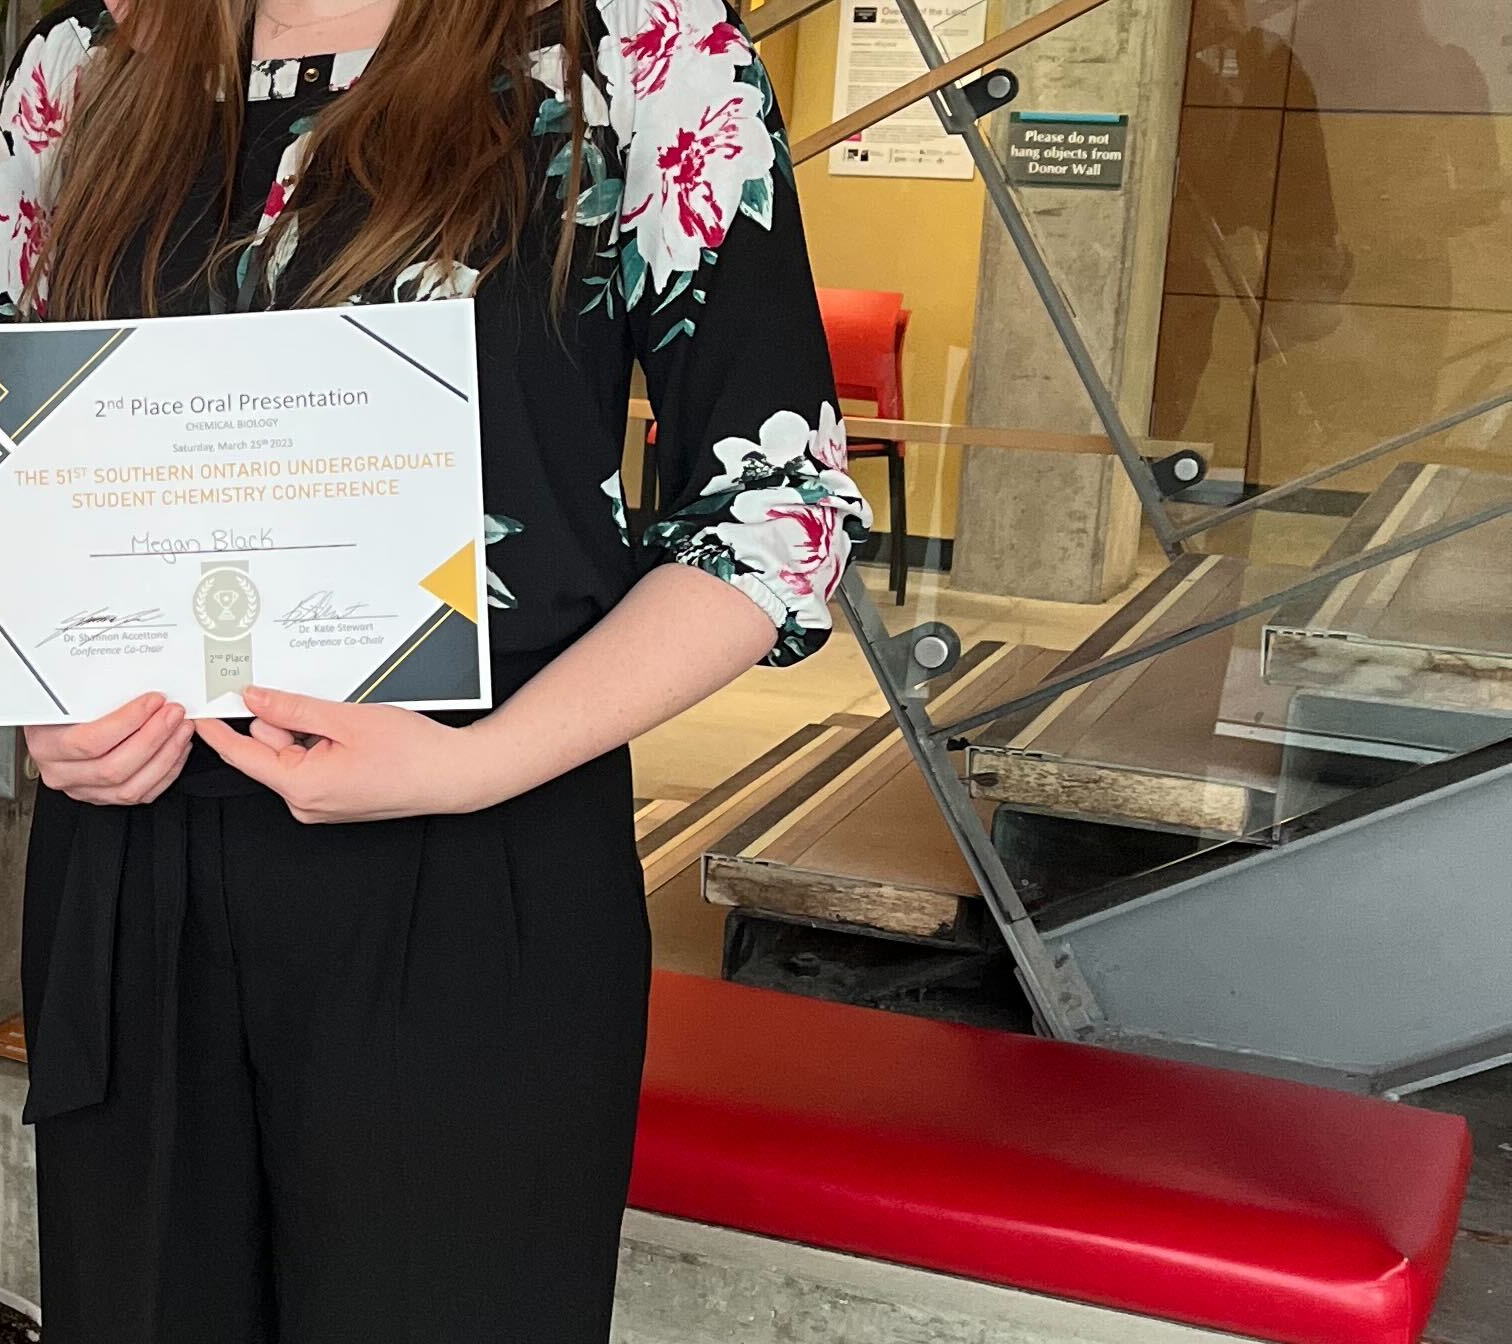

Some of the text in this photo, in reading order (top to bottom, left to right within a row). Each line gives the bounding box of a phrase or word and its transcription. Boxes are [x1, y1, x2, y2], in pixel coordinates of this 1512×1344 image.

[1025, 130, 1110, 145] Please do not
[1010, 144, 1122, 161] hang objects from
[1028, 162, 1102, 176] Donor Wall
[95, 388, 369, 418] 2nd Place Oral Presentation
[185, 417, 279, 432] CHEMICAL BIOLOGY
[217, 440, 248, 451] March
[270, 438, 294, 449] 2023
[14, 451, 456, 486] THE 51ST SOUTHERN ONTARIO UNDERGRADUATE
[72, 479, 401, 510] STUDENT CHEMISTRY CONFERENCE
[131, 527, 274, 564] Megan Black
[314, 623, 336, 633] Kate
[337, 622, 374, 633] Stewart
[344, 635, 384, 646] Co-Chair
[70, 644, 165, 657] Conference Co-Chair
[225, 653, 250, 663] Place
[220, 666, 240, 677] Oral
